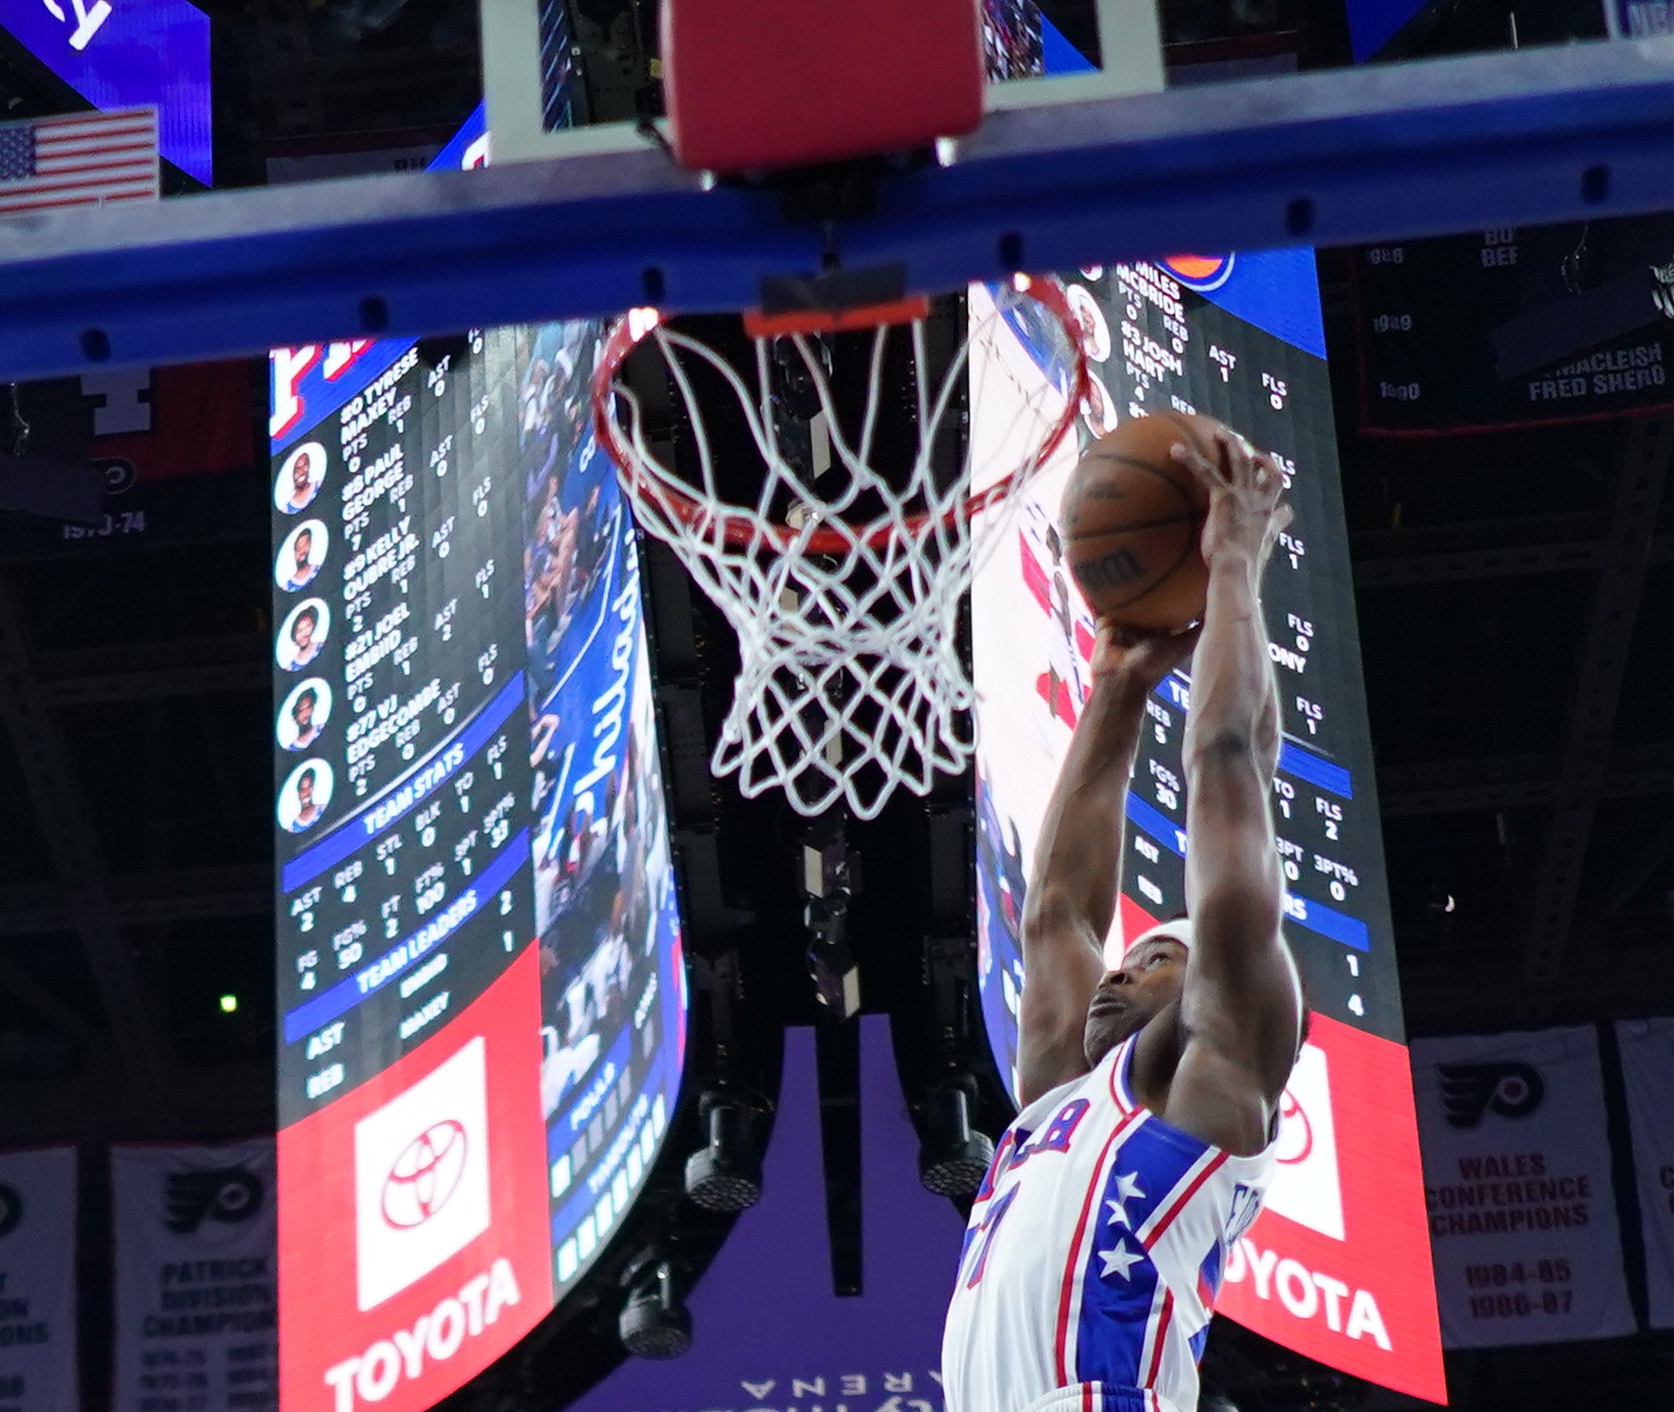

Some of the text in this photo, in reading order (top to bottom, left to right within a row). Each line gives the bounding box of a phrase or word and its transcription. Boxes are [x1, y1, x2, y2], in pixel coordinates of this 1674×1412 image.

[1116, 263, 1185, 324] MCBRIDE
[1118, 281, 1142, 309] PTS
[1136, 261, 1181, 300] MILES
[1163, 315, 1189, 342] REB
[1121, 321, 1183, 377] #3 JOSH
[1123, 339, 1166, 383] HART
[1209, 345, 1237, 370] AST
[364, 347, 419, 405] TYRESE
[1126, 361, 1150, 390] PTS
[1262, 372, 1288, 397] FLS
[1529, 365, 1666, 401] FRED SHERO
[341, 387, 397, 445] MAXEY
[343, 433, 368, 461] PTS
[428, 355, 451, 389] AST
[1270, 393, 1283, 411] 0
[364, 443, 404, 485] PAUL
[430, 434, 454, 468] AST
[342, 461, 404, 521] GEORGE
[365, 515, 411, 565] KELLY
[1279, 532, 1305, 556] FLS
[343, 549, 397, 601] OUBRE
[1289, 553, 1299, 570] 1
[375, 602, 411, 641] JOEL
[1287, 613, 1314, 637] FLS
[347, 678, 442, 765] EDGECOMBE
[1146, 696, 1324, 728] REB FLS
[362, 742, 465, 835] TEAM STATS
[1315, 797, 1344, 822] FLS
[1276, 836, 1359, 887] 3PT 3PT%
[1329, 880, 1346, 902] 0
[356, 946, 409, 994] TEAM
[408, 889, 477, 960] LEADERS
[1346, 954, 1360, 978] 1
[1348, 993, 1365, 1017] 4
[306, 1021, 346, 1061] AST
[1458, 1153, 1547, 1181] WALES
[1425, 1174, 1592, 1211] CONFERENCE
[1430, 1203, 1590, 1238] CHAMPIONS
[163, 1257, 268, 1285] PATRICK
[1466, 1258, 1572, 1289] 1984-85
